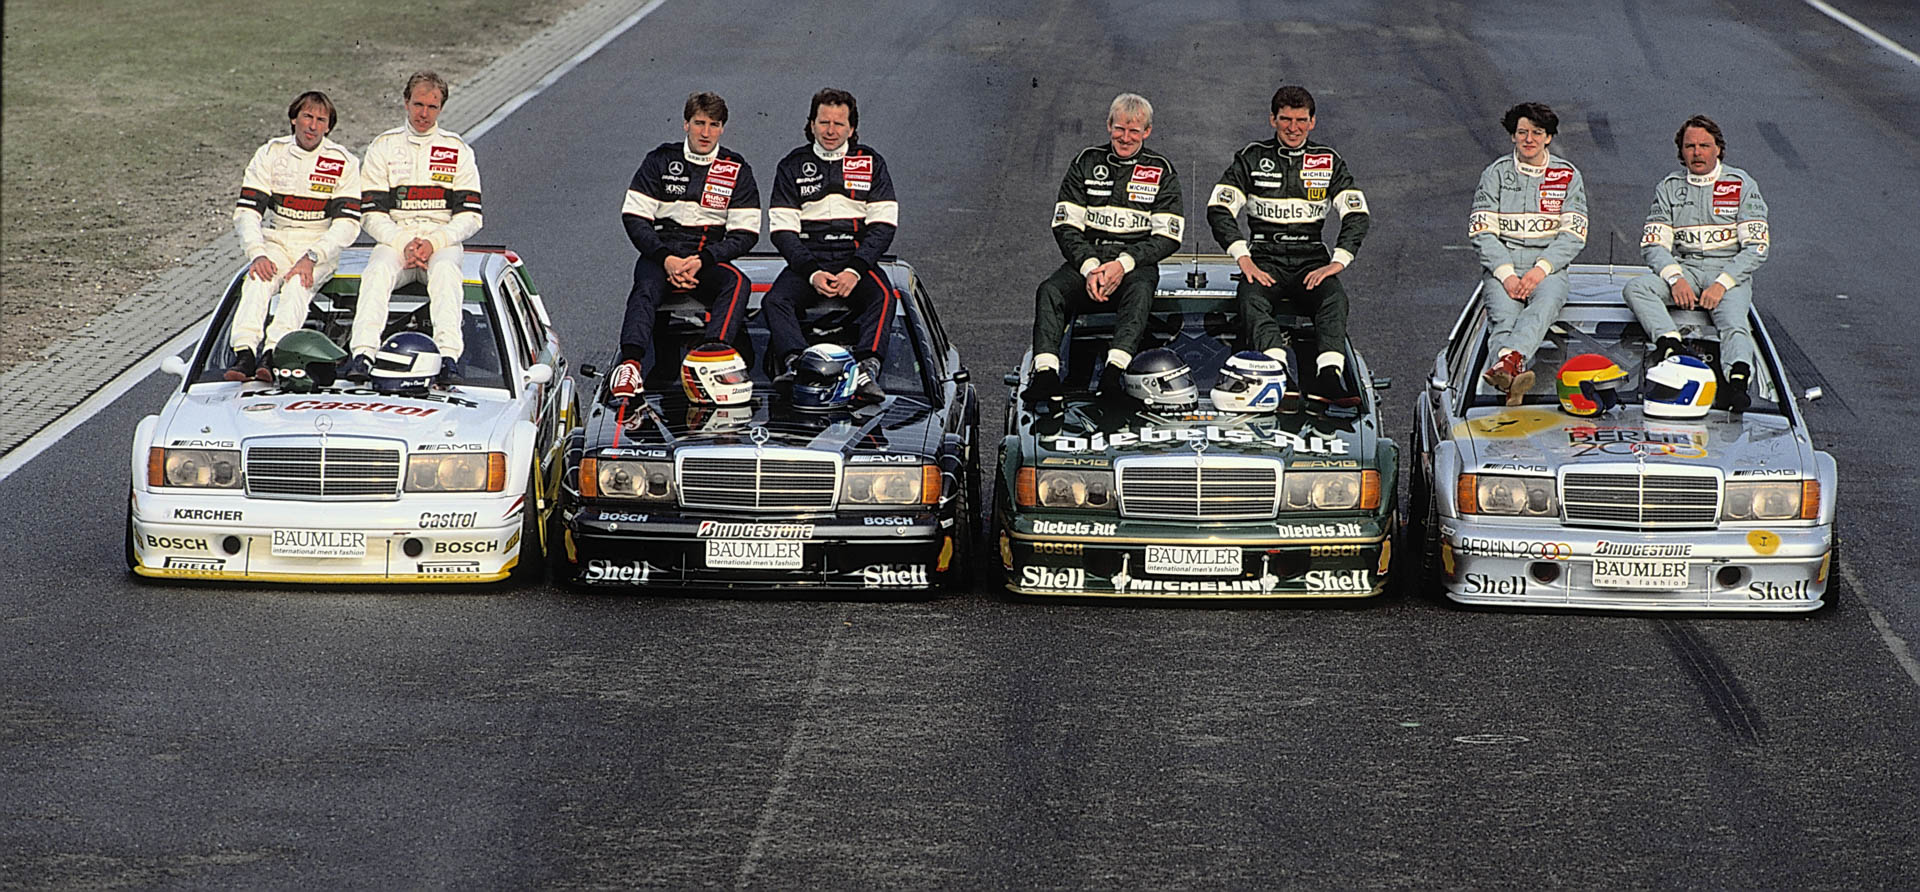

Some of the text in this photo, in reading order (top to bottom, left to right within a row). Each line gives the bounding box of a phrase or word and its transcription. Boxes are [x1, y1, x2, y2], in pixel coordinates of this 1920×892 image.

[1129, 184, 1157, 193] MICHELIN
[284, 401, 440, 417] Castrol
[189, 440, 234, 448] AMG
[1569, 430, 1703, 445] BERLIN
[437, 443, 482, 451] AMG
[621, 449, 667, 457] AMG
[870, 455, 917, 463] AMG
[1062, 458, 1109, 466] AMG
[1310, 460, 1358, 468] AMG
[1502, 463, 1548, 472] AMG
[173, 508, 243, 521] KÄRCHER
[418, 511, 478, 529] Castrol
[599, 512, 649, 522] BOSCH
[863, 516, 914, 526] BOSCH
[700, 522, 814, 539] BRIDGESTONE
[146, 534, 209, 551] BOSCH
[273, 530, 365, 549] BÄUMLER
[434, 540, 499, 554] BOSCH
[708, 541, 801, 558] BÄUMLER
[1033, 542, 1084, 556] BOSCH
[1309, 544, 1362, 557] BOSCH
[1461, 537, 1573, 560] BERLIN 2000
[1594, 541, 1692, 557] BRIDGESTONE
[1147, 547, 1240, 565] BÄUMLER
[163, 556, 227, 572] PIRELLI
[416, 561, 480, 573] PIRELLI
[586, 559, 650, 582] Shell
[1191, 565, 1213, 573] men's
[1214, 565, 1240, 573] fashion
[1595, 559, 1687, 578] BÄUMLER
[863, 564, 929, 586] Shell
[1020, 566, 1085, 590] Shell
[1304, 569, 1372, 592] Shell
[1639, 578, 1687, 586] fashion
[1131, 578, 1263, 592] MICHELIN
[1464, 572, 1527, 596] Shell
[1748, 579, 1810, 601] Shell
